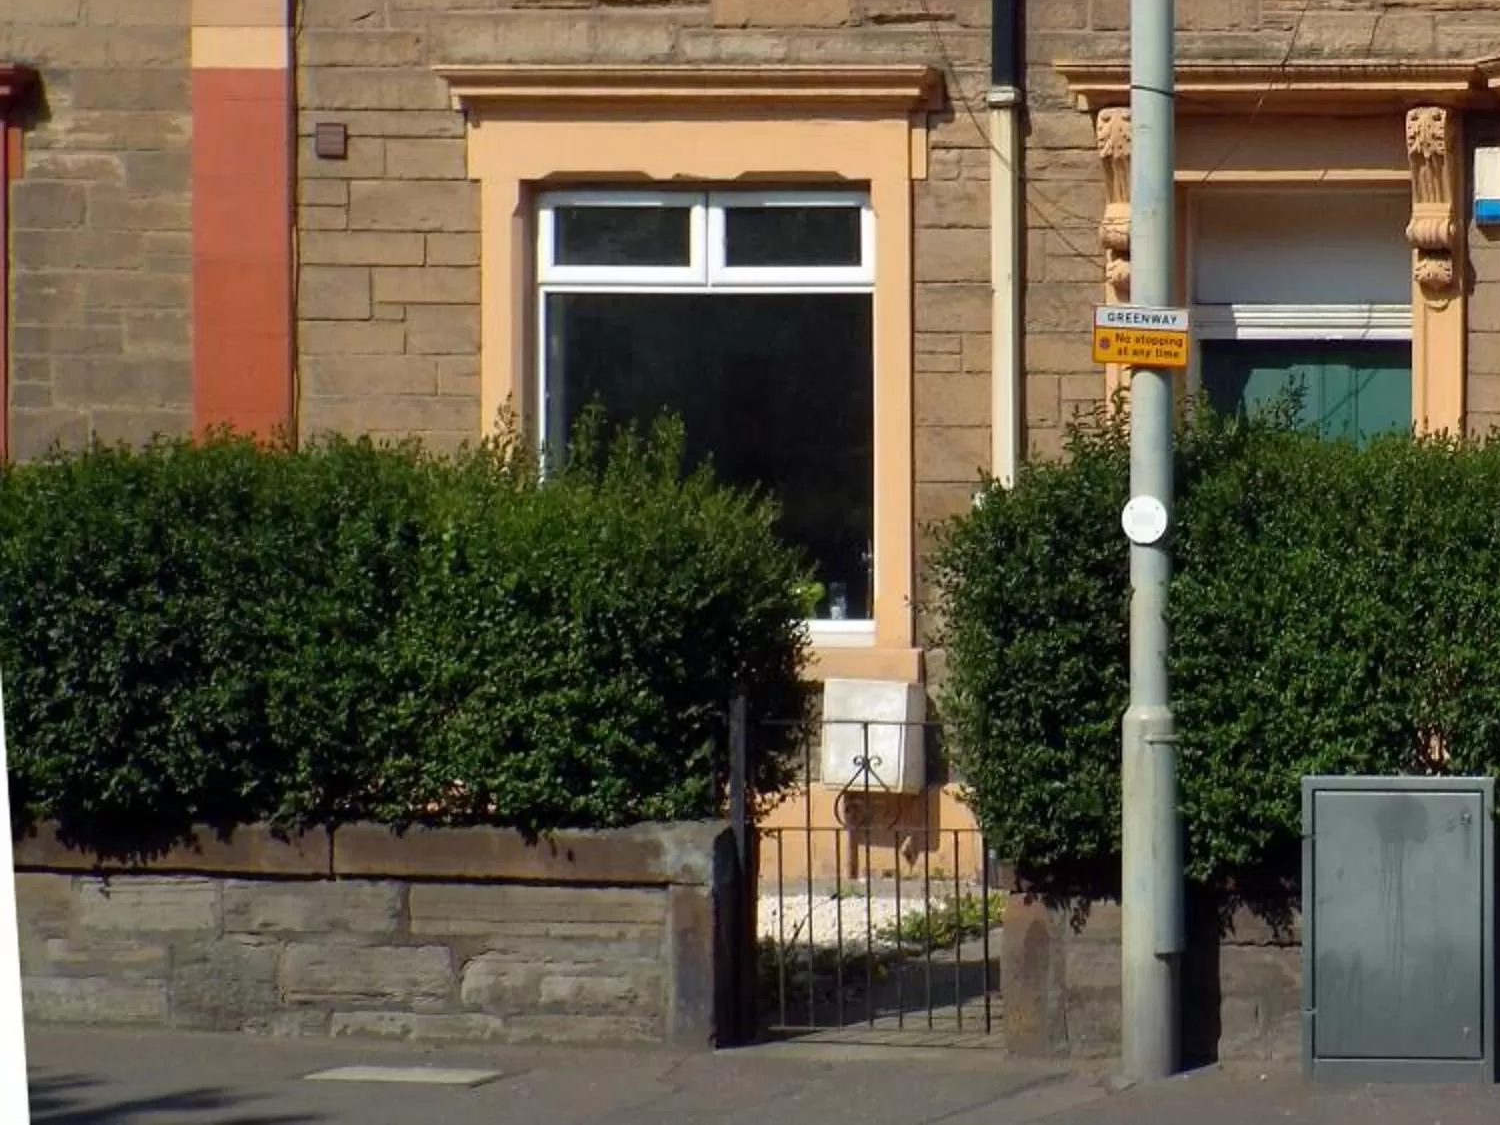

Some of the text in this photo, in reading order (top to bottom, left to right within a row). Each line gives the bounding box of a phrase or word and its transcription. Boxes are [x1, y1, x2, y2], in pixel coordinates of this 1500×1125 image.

[1107, 312, 1177, 325] GREENWAY
[1115, 332, 1183, 348] No stopping
[1117, 346, 1179, 358] at any time
